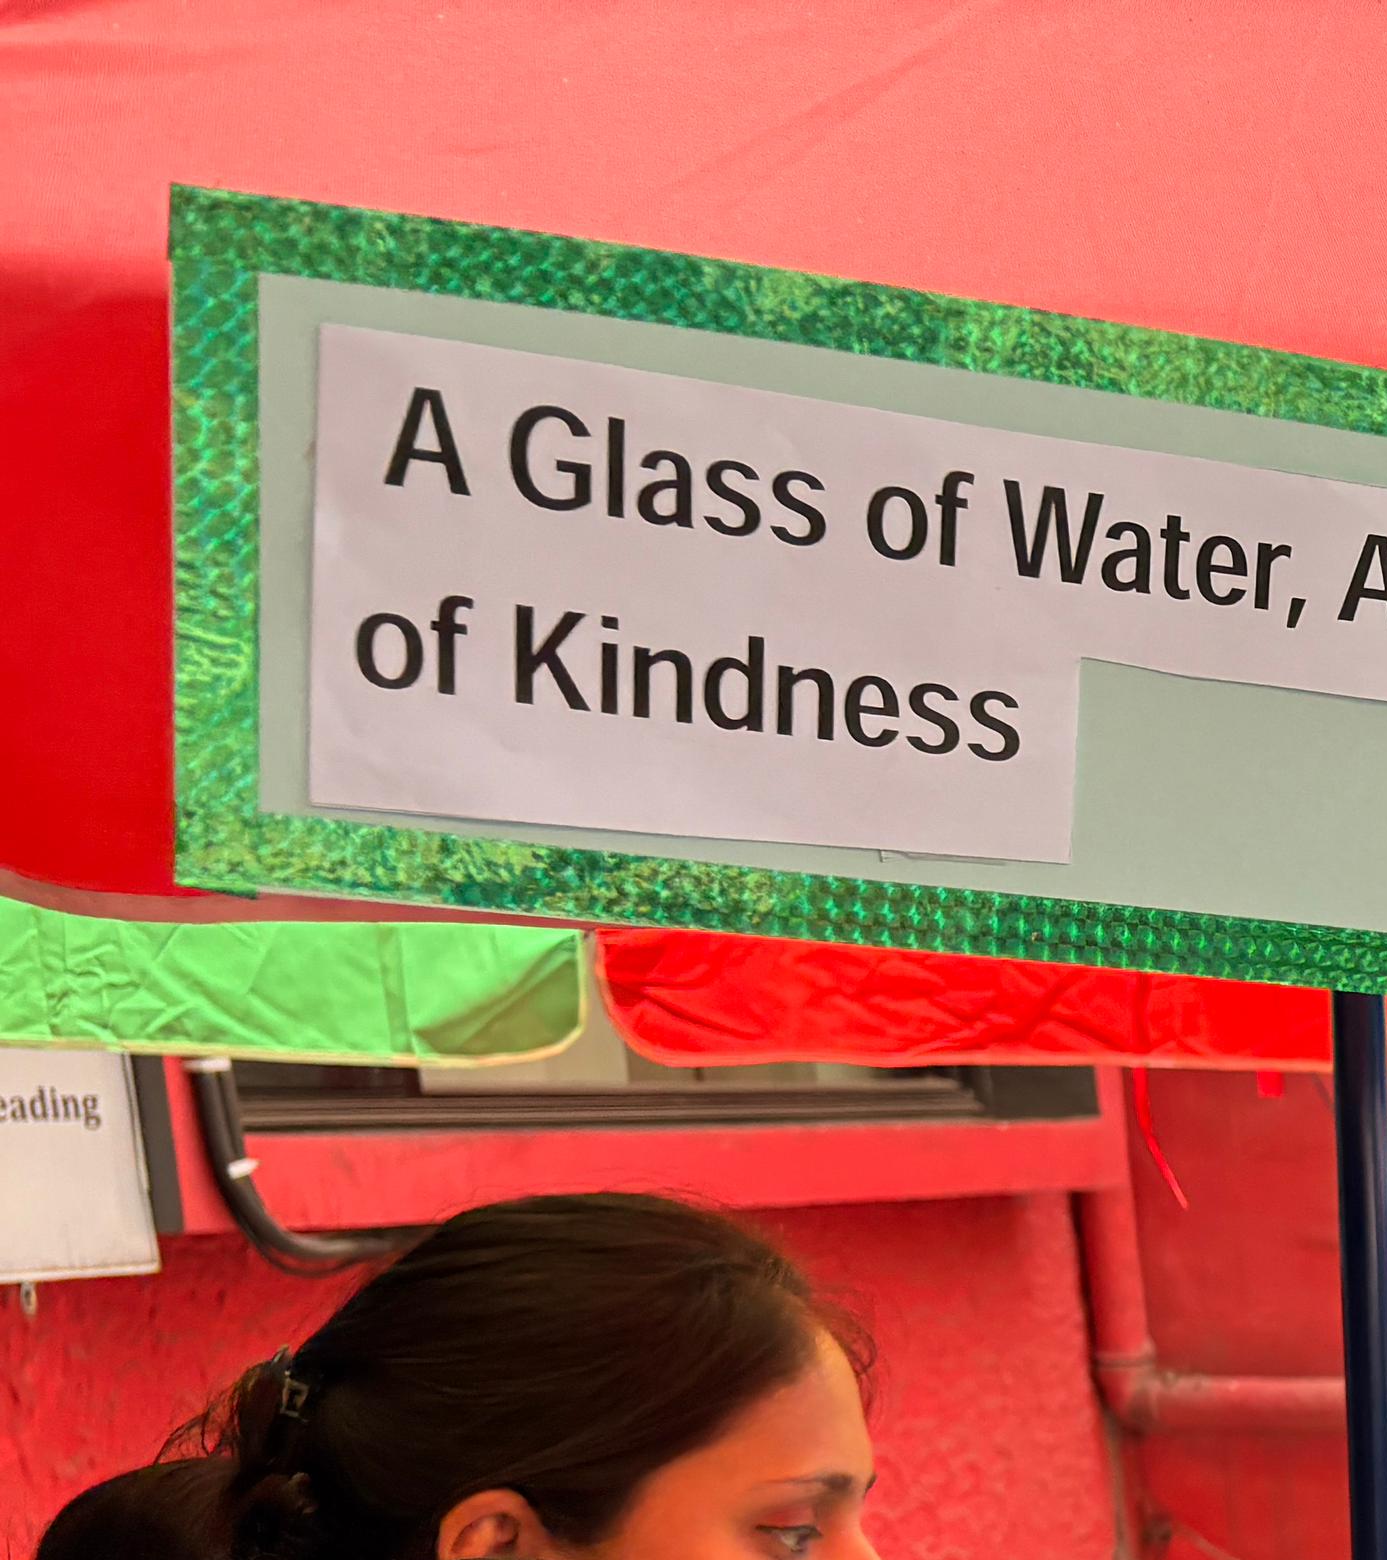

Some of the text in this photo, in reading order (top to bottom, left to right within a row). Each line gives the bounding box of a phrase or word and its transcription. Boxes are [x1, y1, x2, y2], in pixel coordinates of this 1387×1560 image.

[383, 386, 472, 498] A
[508, 404, 828, 548] Glass
[865, 469, 977, 568] of
[1002, 477, 1308, 630] Water,
[355, 594, 1021, 763] of Kindness
